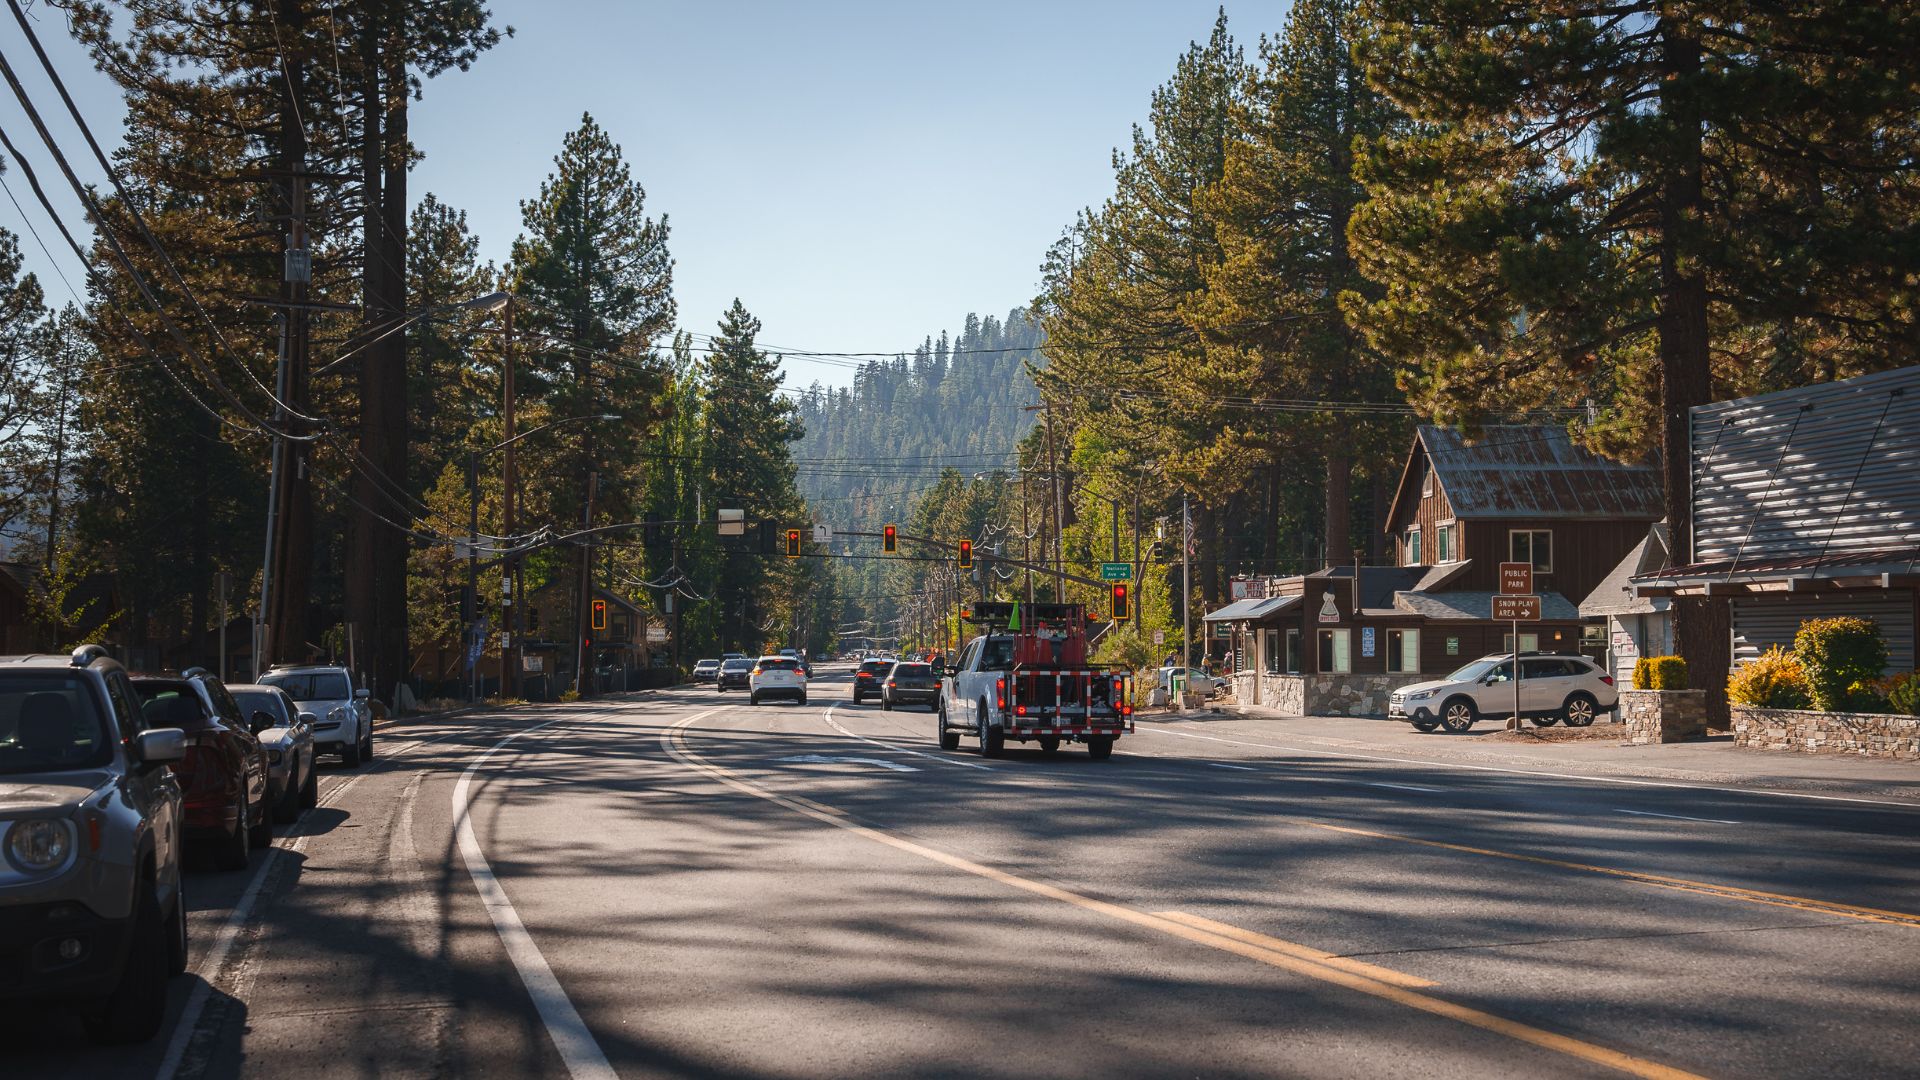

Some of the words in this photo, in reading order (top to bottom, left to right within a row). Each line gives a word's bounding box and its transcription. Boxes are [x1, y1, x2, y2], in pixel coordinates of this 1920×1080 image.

[1504, 569, 1528, 577] PUBLIC
[1507, 580, 1525, 588] PARK
[1498, 609, 1516, 617] AREA
